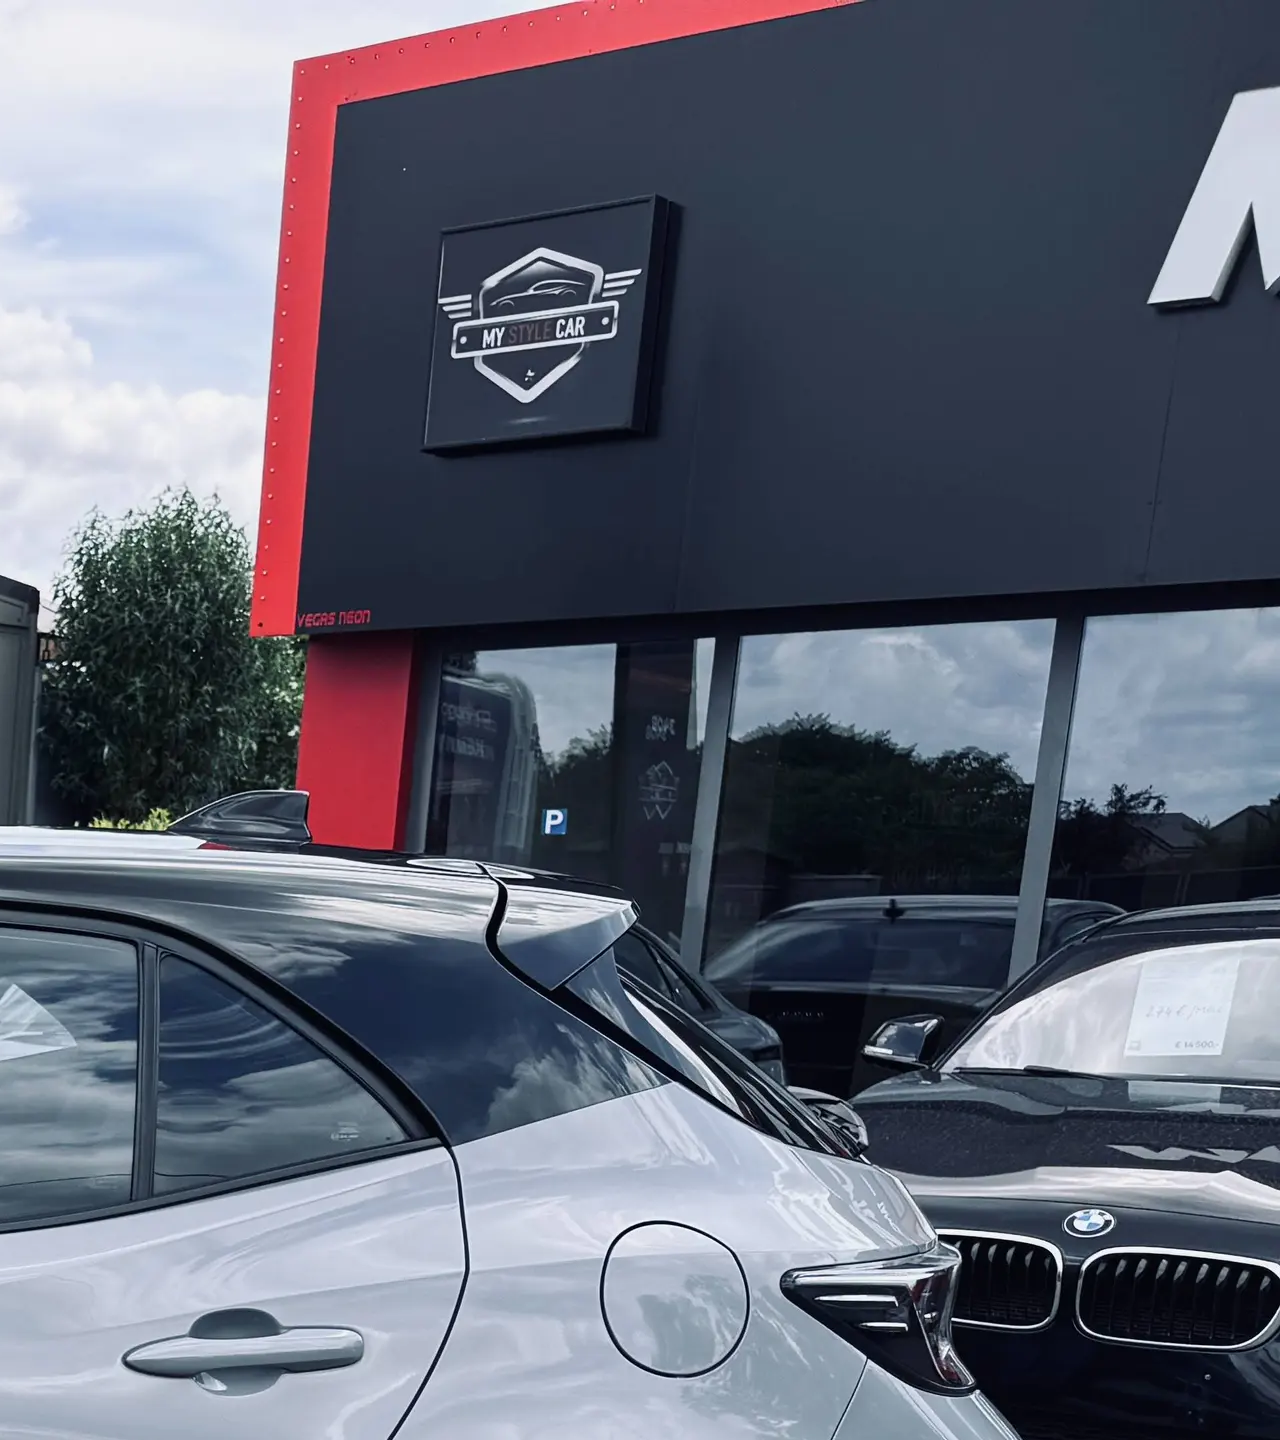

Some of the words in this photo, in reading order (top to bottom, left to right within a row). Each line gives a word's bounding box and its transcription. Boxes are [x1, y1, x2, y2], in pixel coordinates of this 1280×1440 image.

[482, 327, 505, 348] MY
[508, 321, 552, 344] STYLE
[555, 316, 586, 339] CAR
[297, 612, 336, 628] VEGAS
[544, 809, 564, 835] P
